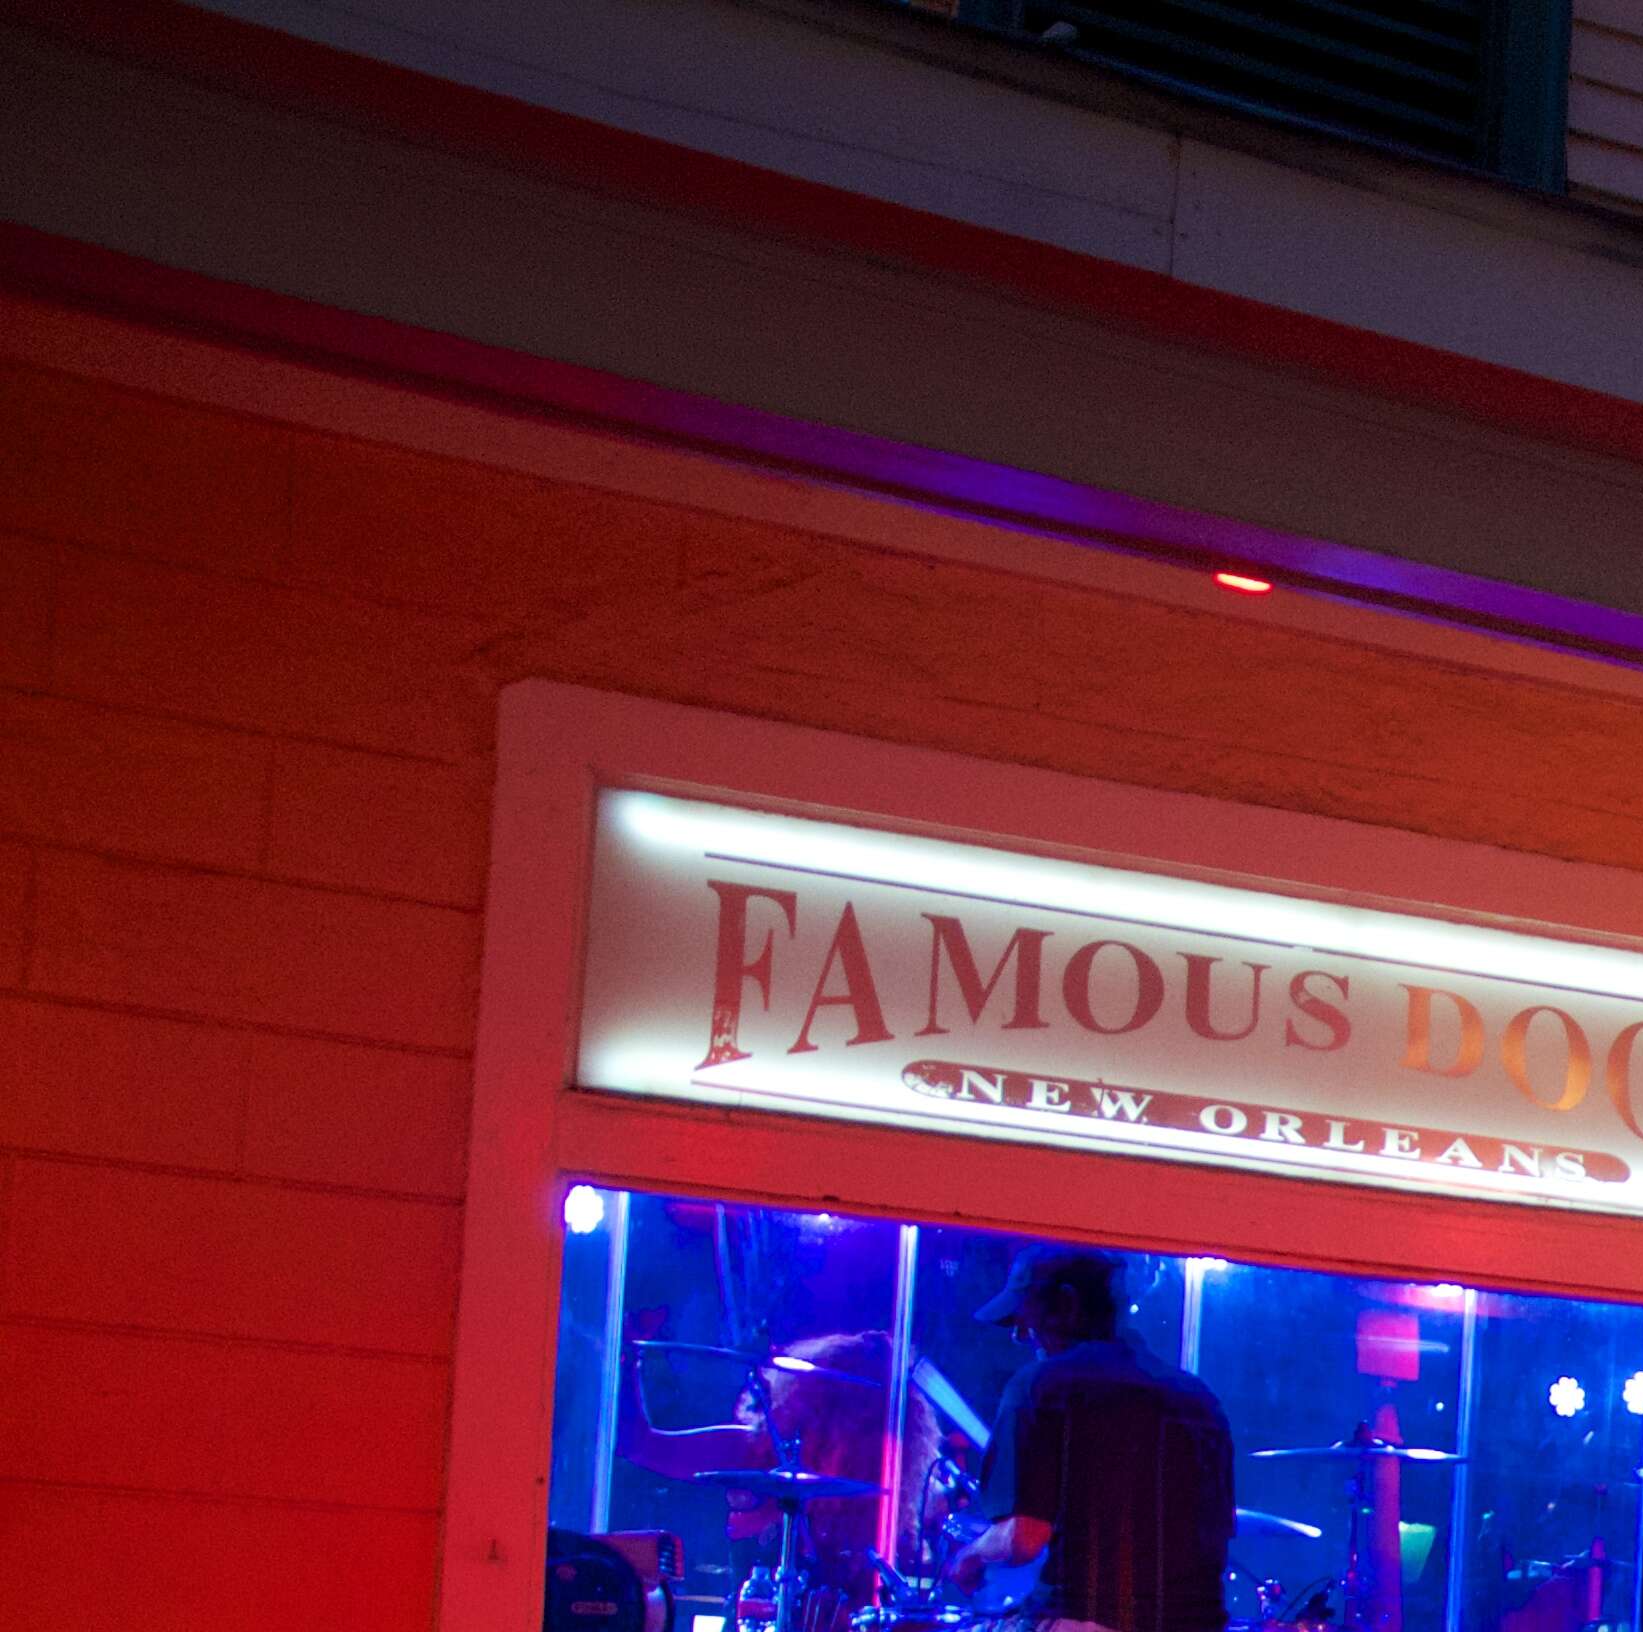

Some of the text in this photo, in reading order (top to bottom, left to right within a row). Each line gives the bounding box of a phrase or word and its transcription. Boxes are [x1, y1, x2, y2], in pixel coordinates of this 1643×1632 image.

[694, 878, 1355, 1071] FAMOUS
[957, 1067, 1590, 1185] NEW ORLEANS
